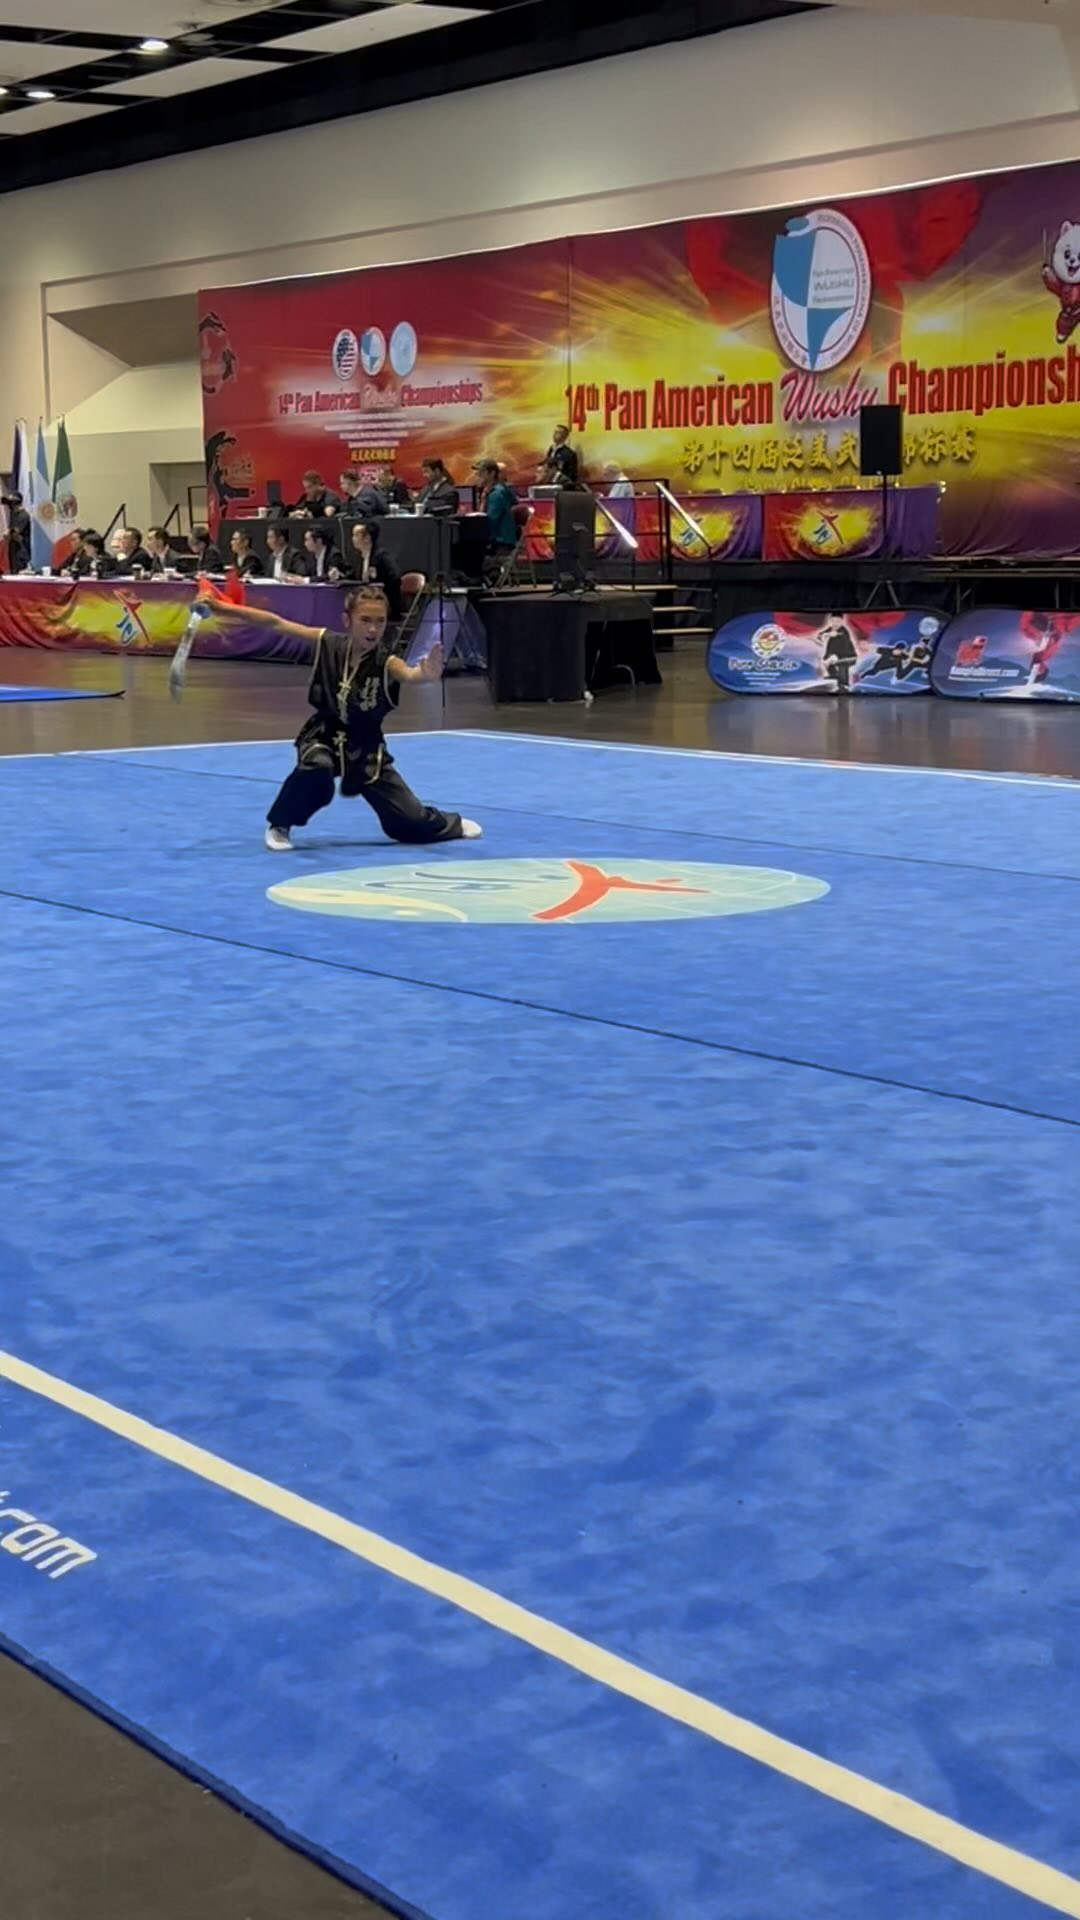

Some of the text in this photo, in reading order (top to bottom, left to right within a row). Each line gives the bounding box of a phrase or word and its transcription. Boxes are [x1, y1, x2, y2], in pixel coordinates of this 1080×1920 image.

[565, 384, 599, 431] 14th
[604, 383, 647, 430] Pan
[652, 374, 773, 428] American
[780, 367, 878, 421] Wushu
